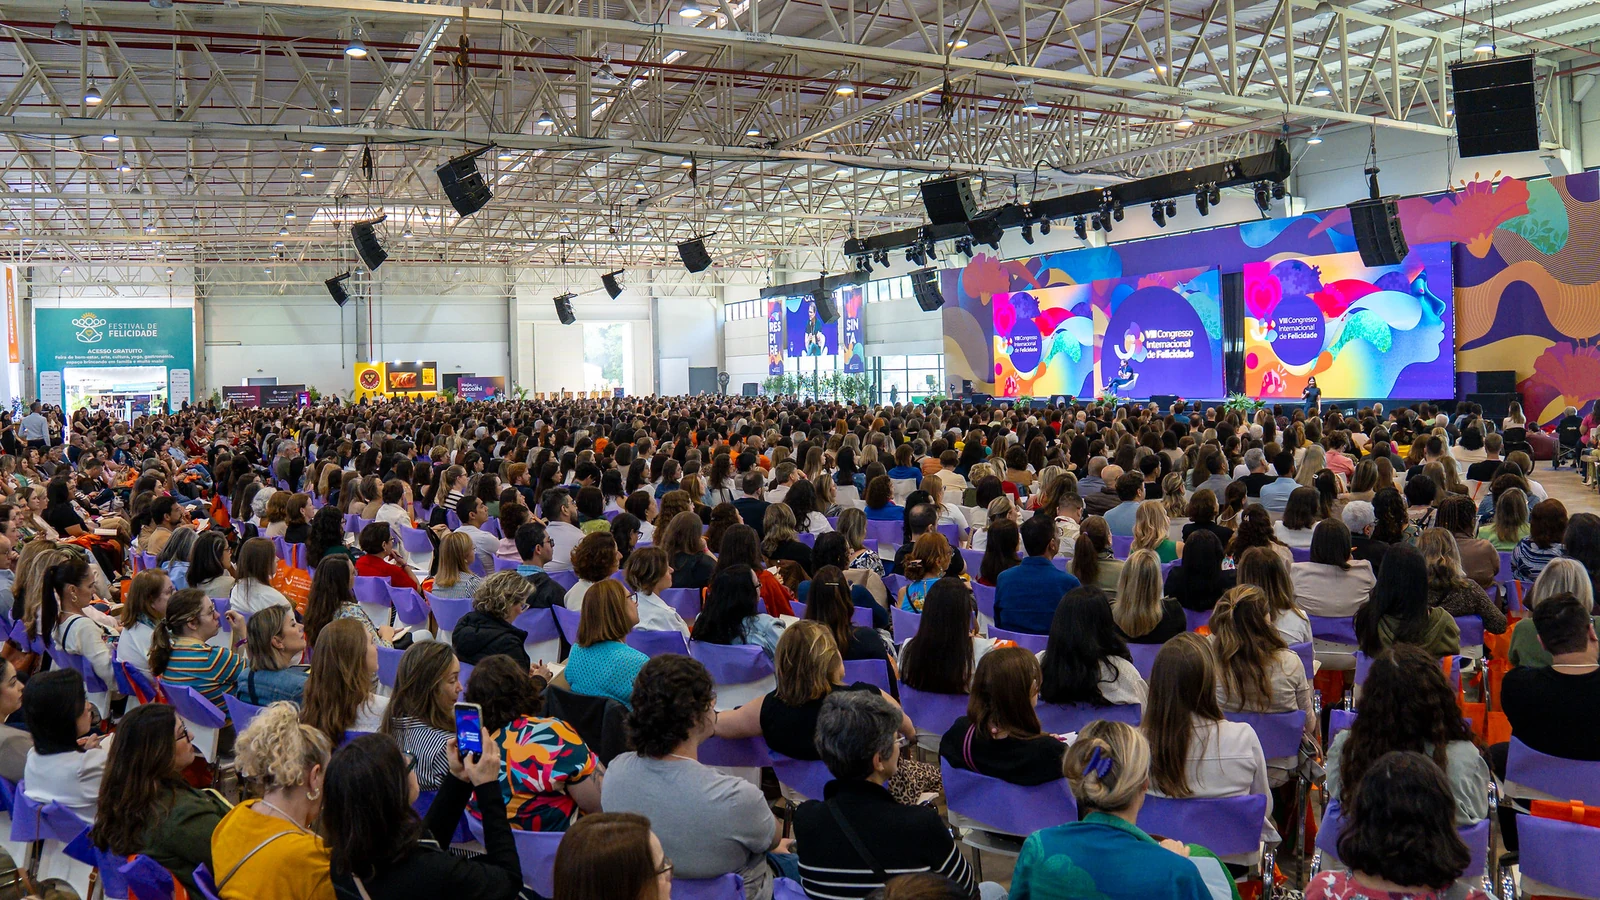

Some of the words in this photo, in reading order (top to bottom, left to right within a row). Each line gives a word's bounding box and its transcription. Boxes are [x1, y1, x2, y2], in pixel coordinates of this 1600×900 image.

[769, 321, 781, 332] RES
[846, 318, 858, 331] SIN
[770, 333, 776, 344] PI
[846, 332, 856, 344] TA
[1145, 330, 1157, 338] VIII
[1158, 330, 1194, 339] Congresso
[1147, 339, 1191, 348] Internacional
[770, 344, 778, 355] RE
[1147, 350, 1156, 358] de
[1156, 349, 1194, 358] Felicidade
